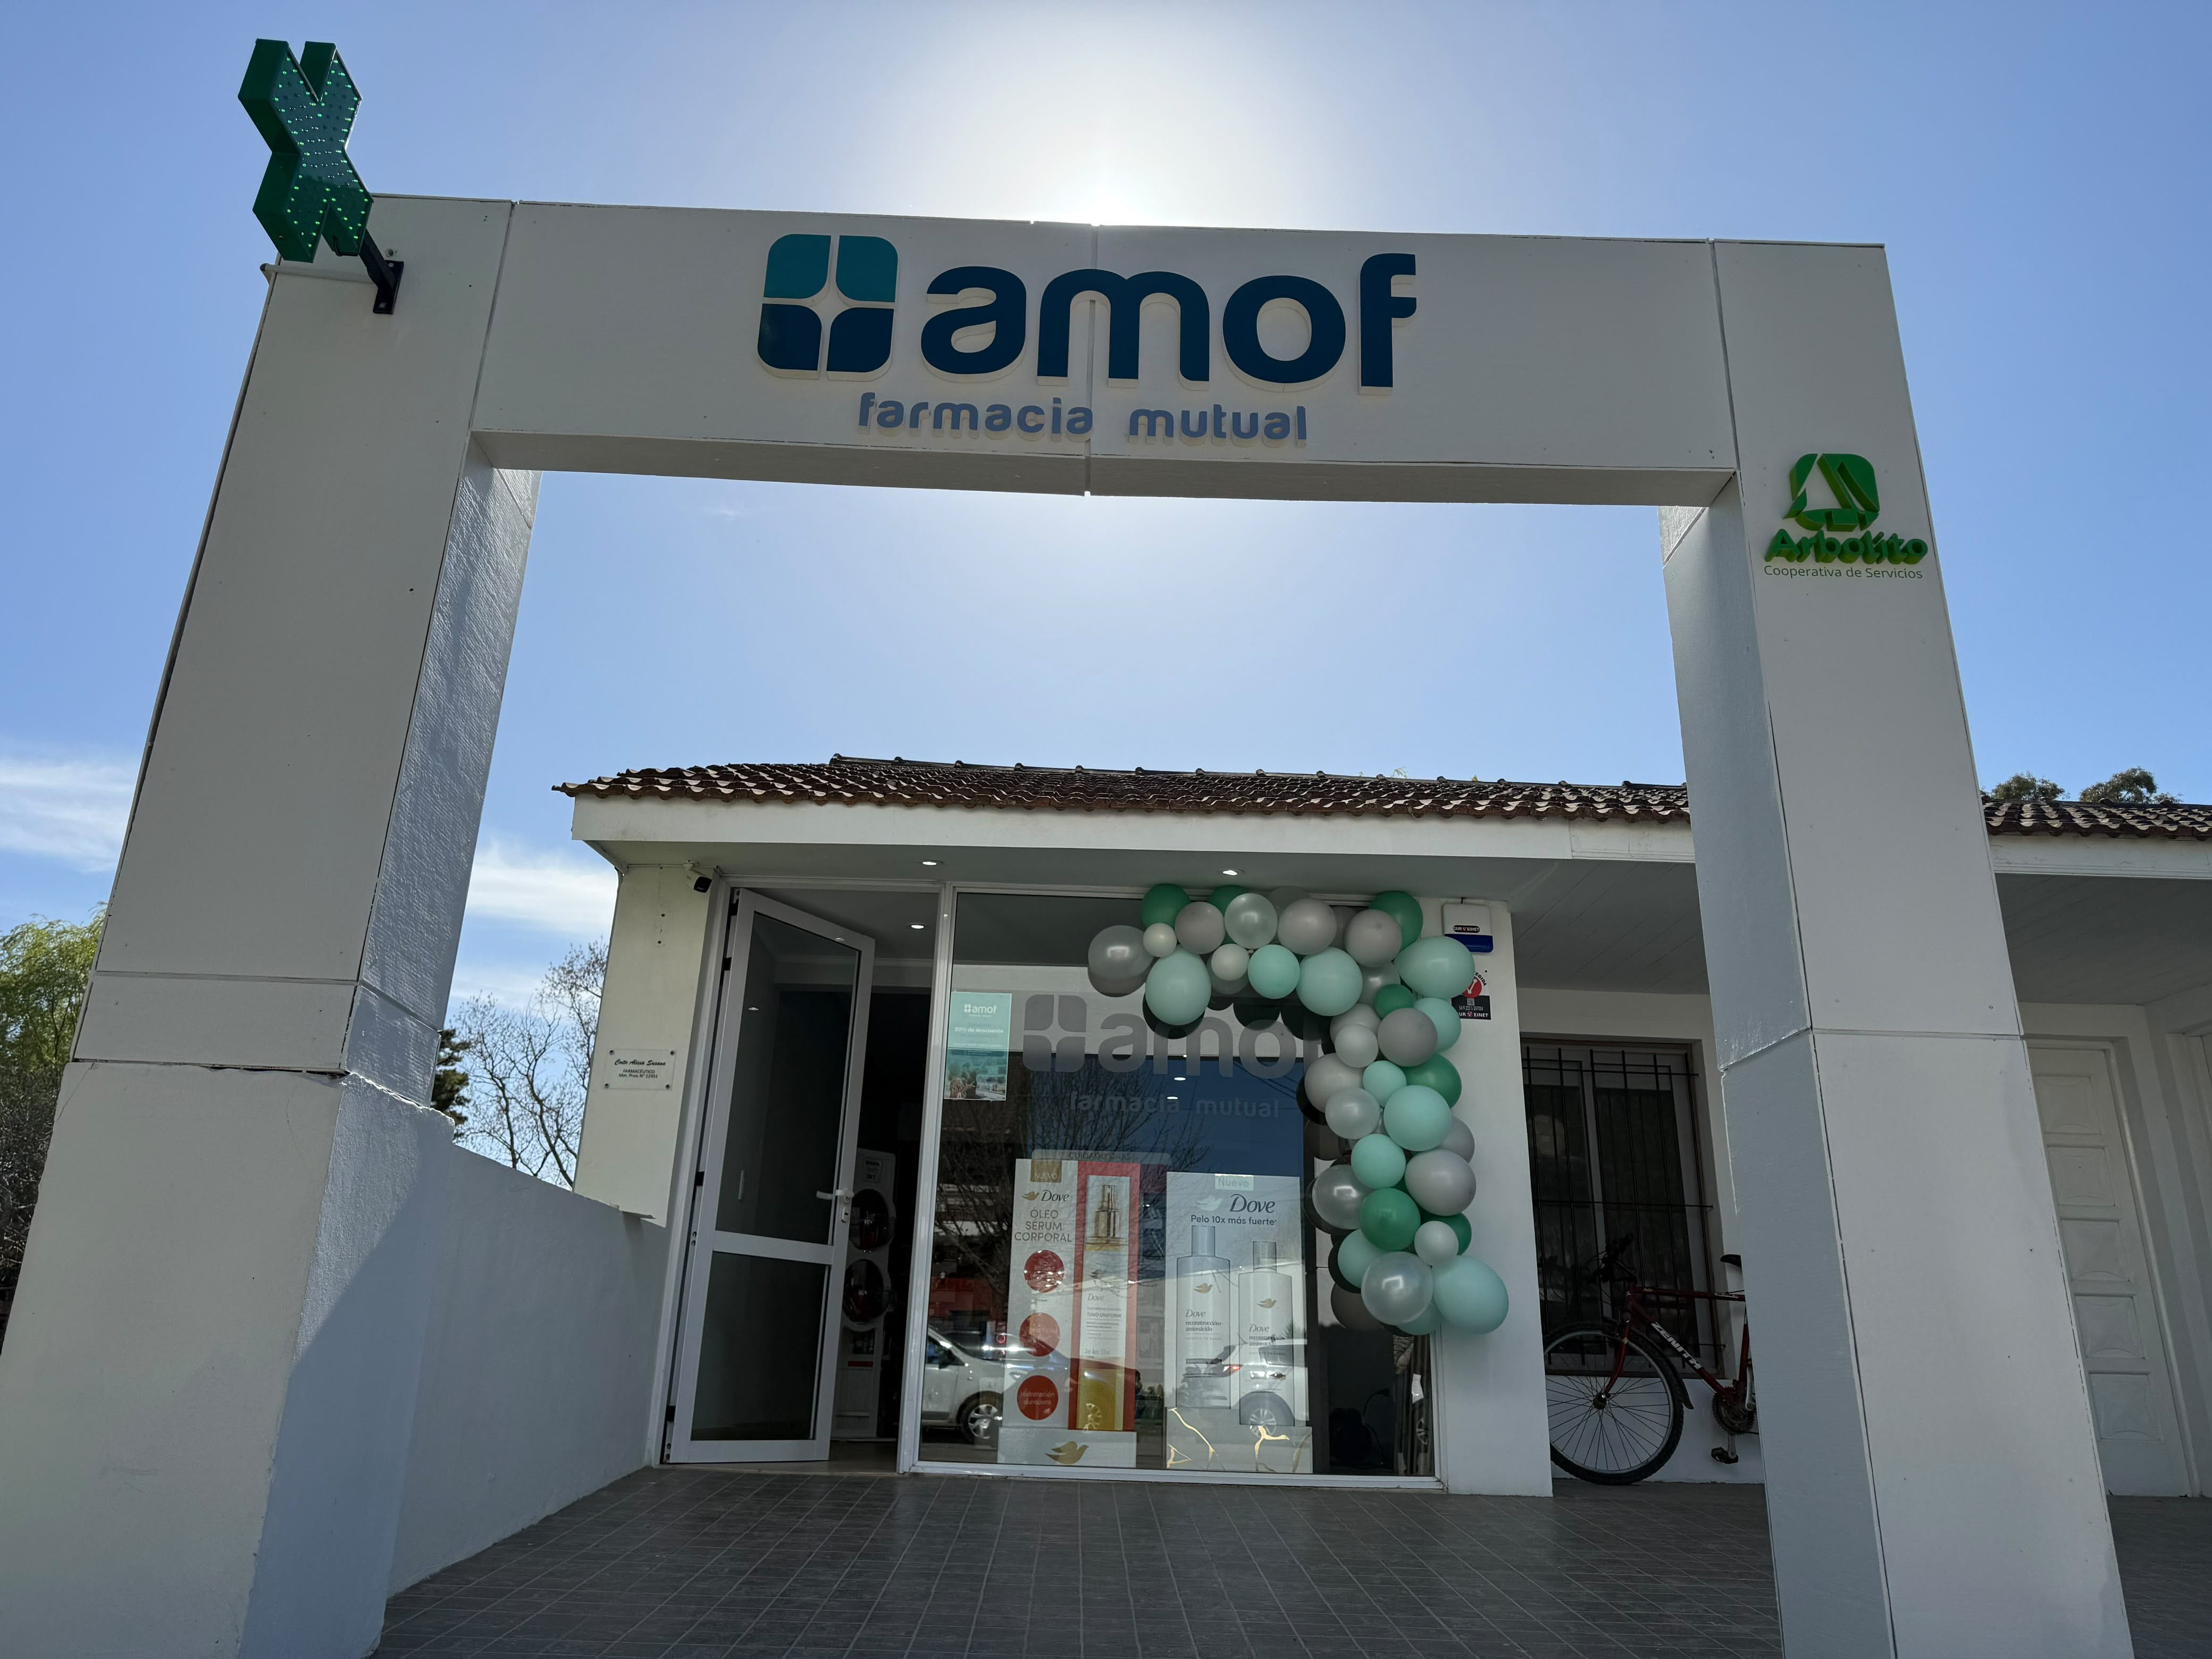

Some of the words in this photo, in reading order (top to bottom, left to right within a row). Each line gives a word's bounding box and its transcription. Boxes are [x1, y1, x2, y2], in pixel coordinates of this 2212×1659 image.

[921, 253, 1417, 390] amof
[857, 392, 1093, 437] farmacia
[1128, 404, 1307, 441] mutual
[1764, 529, 1928, 565] Arbolito
[1764, 565, 1842, 579] Cooperativa
[1846, 567, 1862, 577] de
[1866, 567, 1923, 579] Servicios
[972, 1005, 997, 1013] amof
[1069, 1090, 1179, 1114] farmacia
[1195, 1097, 1279, 1118] mutual
[1218, 1178, 1249, 1187] Nuevo
[1041, 1189, 1070, 1202] Dove
[1229, 1194, 1276, 1213] Dove
[1030, 1208, 1059, 1219] ÓLEO
[1025, 1220, 1062, 1231] SÉRUM
[1014, 1231, 1073, 1243] CORPORAL
[1185, 1309, 1206, 1317] Dove
[1249, 1323, 1270, 1332] Dove
[1651, 1321, 1702, 1370] ZENITH
